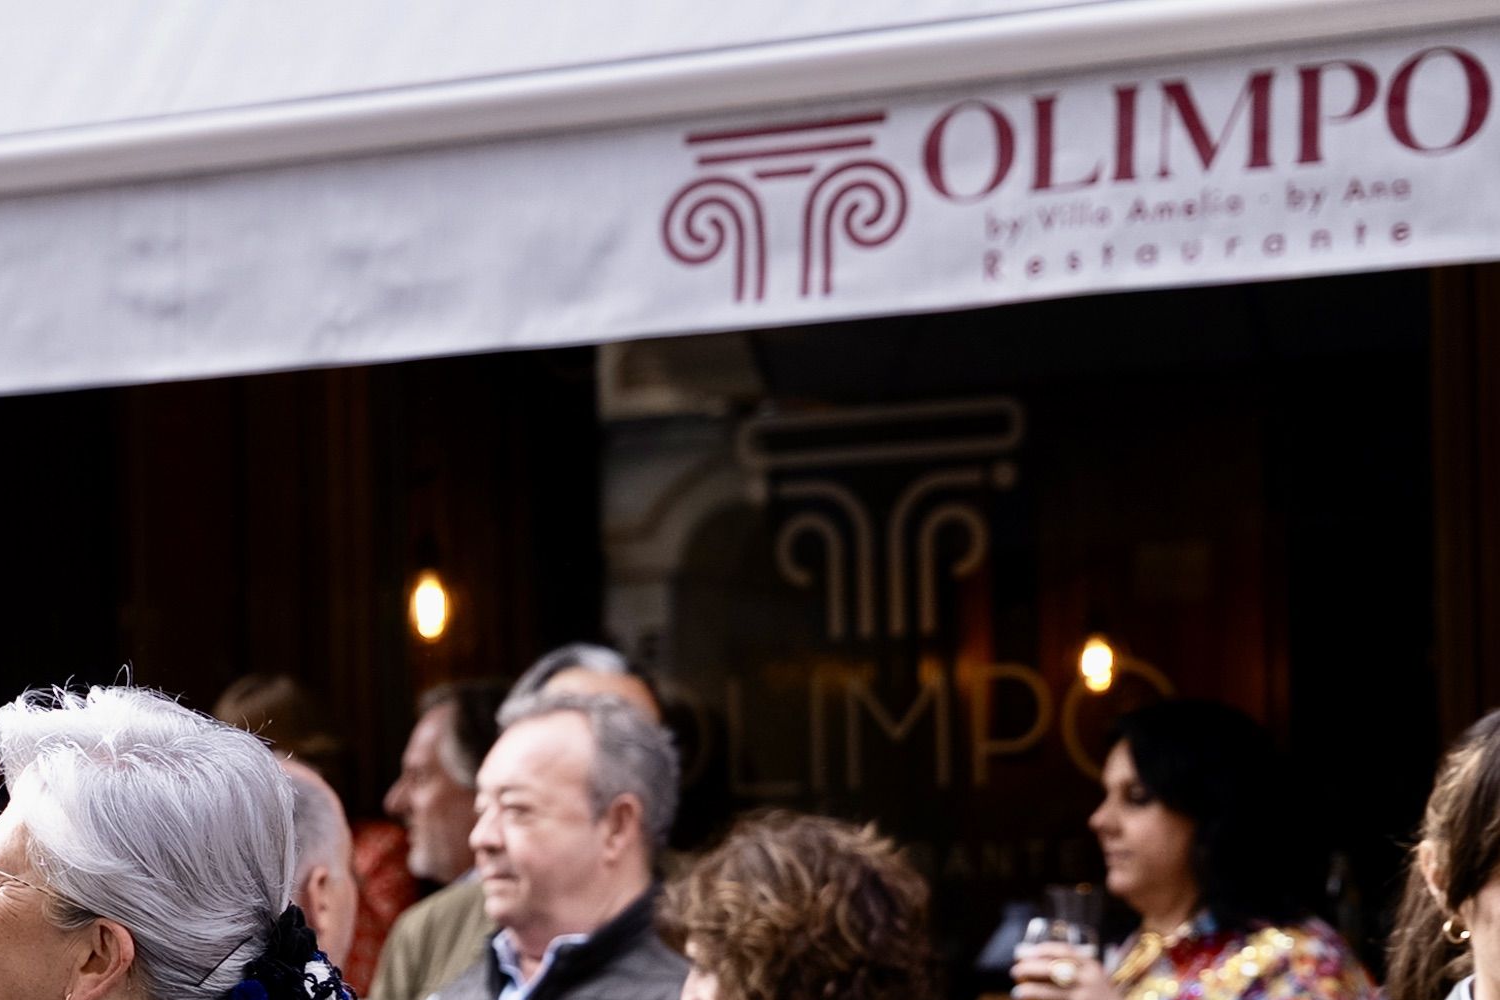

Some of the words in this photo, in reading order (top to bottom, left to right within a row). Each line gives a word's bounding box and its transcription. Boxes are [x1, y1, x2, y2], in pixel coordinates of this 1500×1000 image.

[921, 46, 1491, 203] OLIMPO
[985, 209, 1023, 243] by
[1128, 187, 1242, 220] Amelia
[1287, 181, 1325, 214] by
[1344, 177, 1411, 200] Ana
[984, 222, 1412, 279] Restaurante
